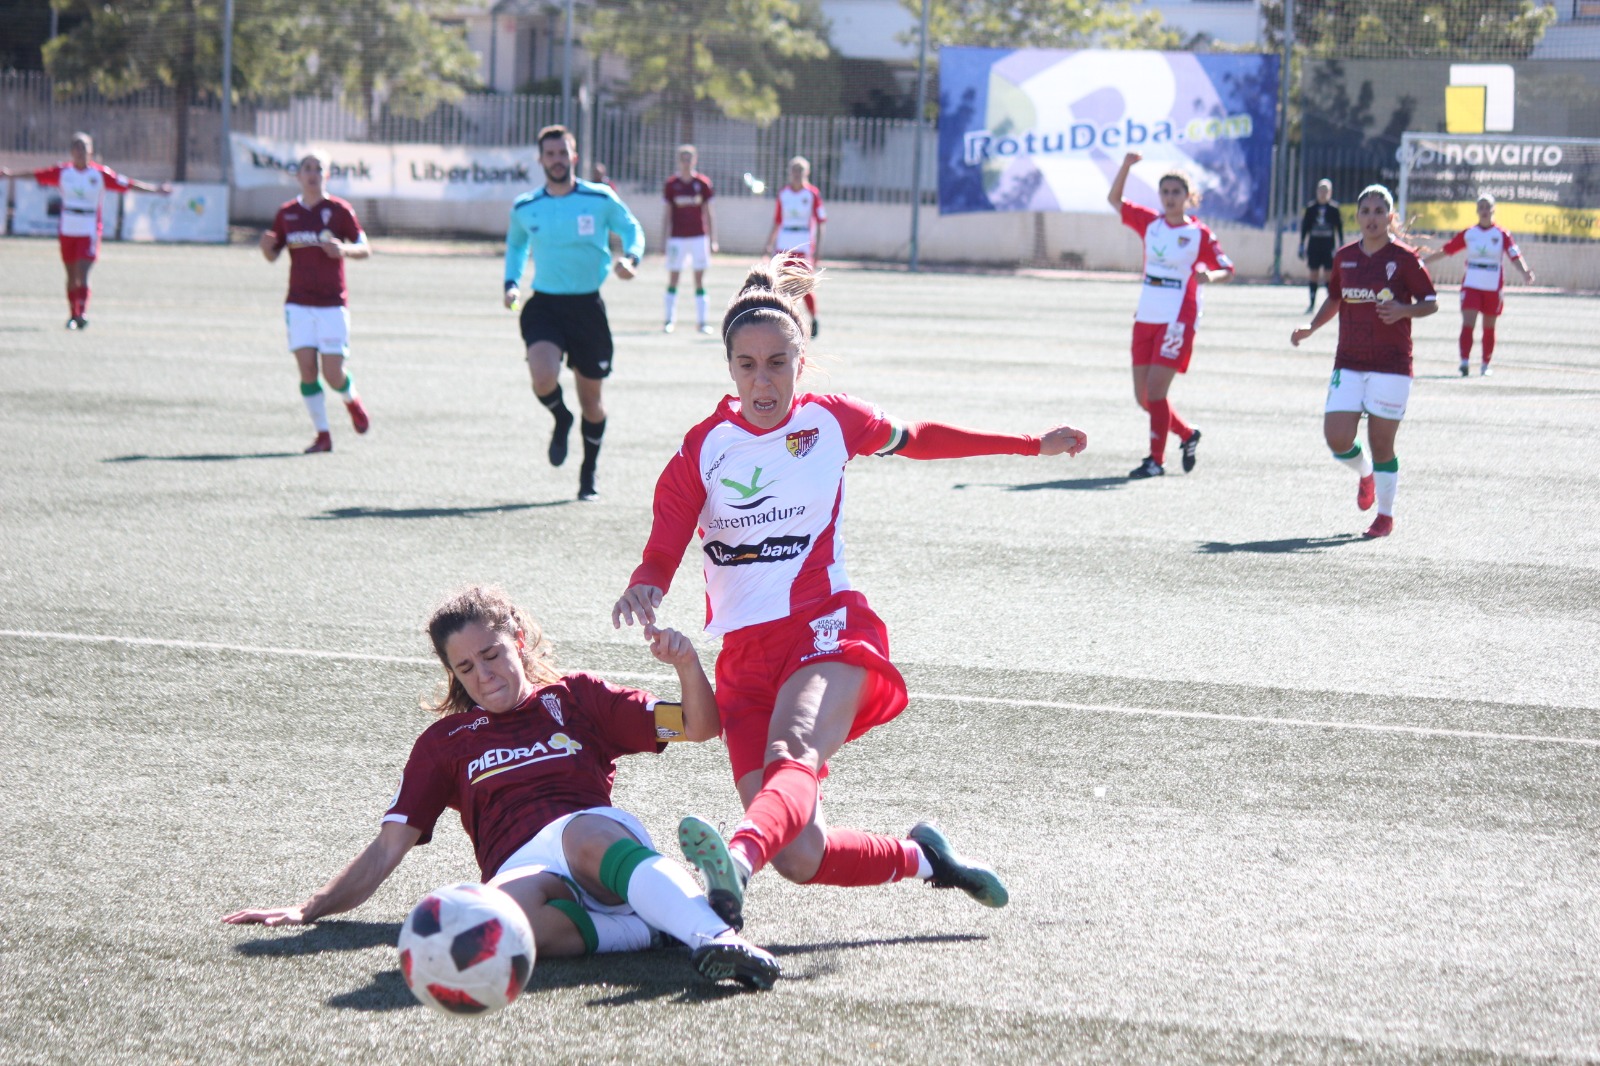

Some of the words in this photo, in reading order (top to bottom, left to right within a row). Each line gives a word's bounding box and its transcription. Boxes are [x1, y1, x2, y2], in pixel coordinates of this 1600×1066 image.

[965, 113, 1253, 164] RotuDeba.com
[410, 161, 531, 184] Liberbank
[1161, 335, 1184, 354] 22
[468, 741, 548, 780] PIEDRA
